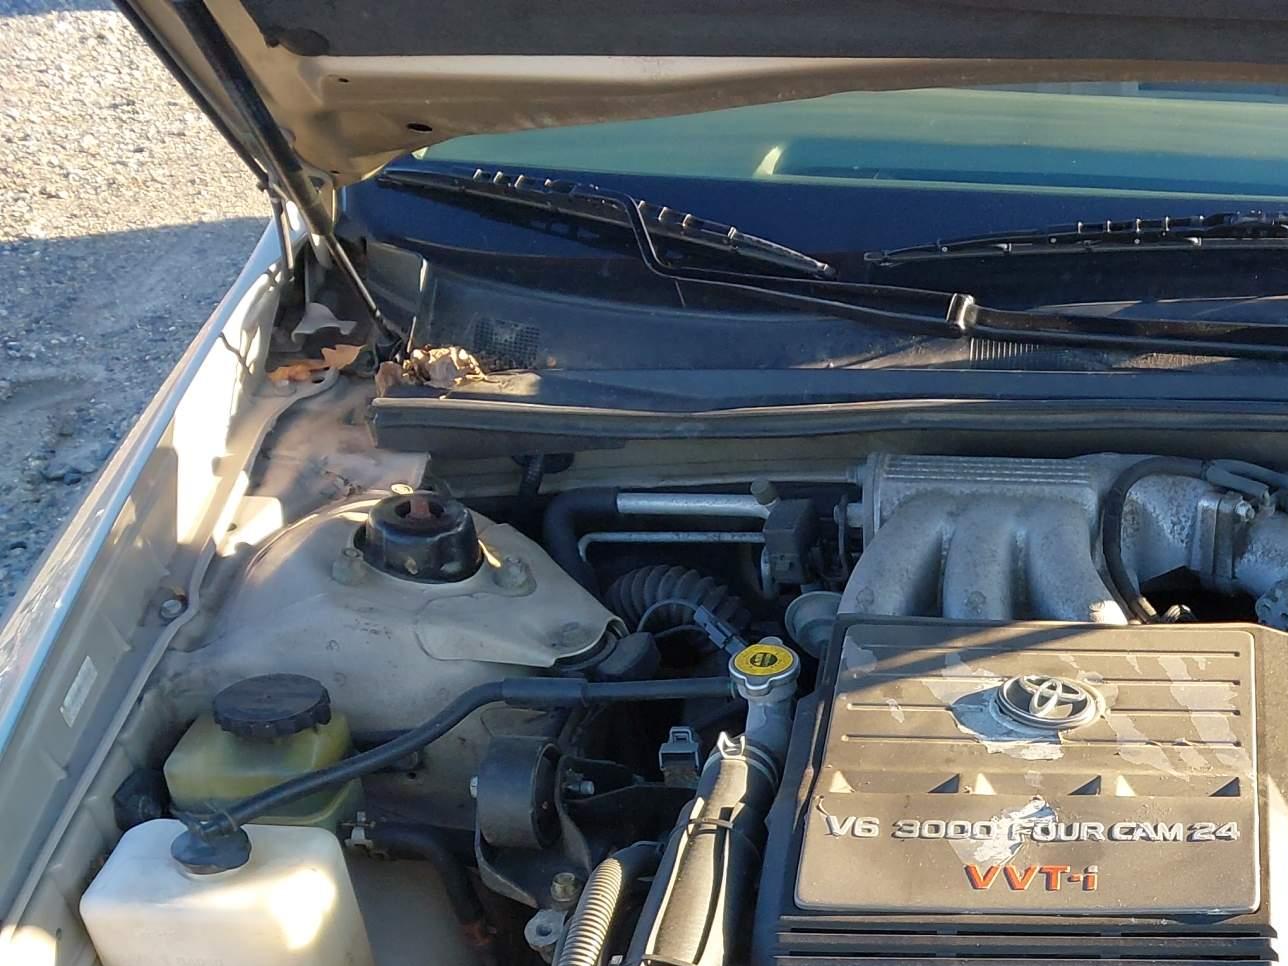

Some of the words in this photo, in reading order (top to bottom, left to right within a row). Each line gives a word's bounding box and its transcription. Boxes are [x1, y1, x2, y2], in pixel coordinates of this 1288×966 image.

[825, 815, 880, 838] V6
[892, 819, 1001, 840] 3000
[1012, 819, 1106, 842] FOUR
[1107, 820, 1184, 842] CAM
[1187, 820, 1242, 842] 24
[964, 863, 1099, 891] VVT-i
